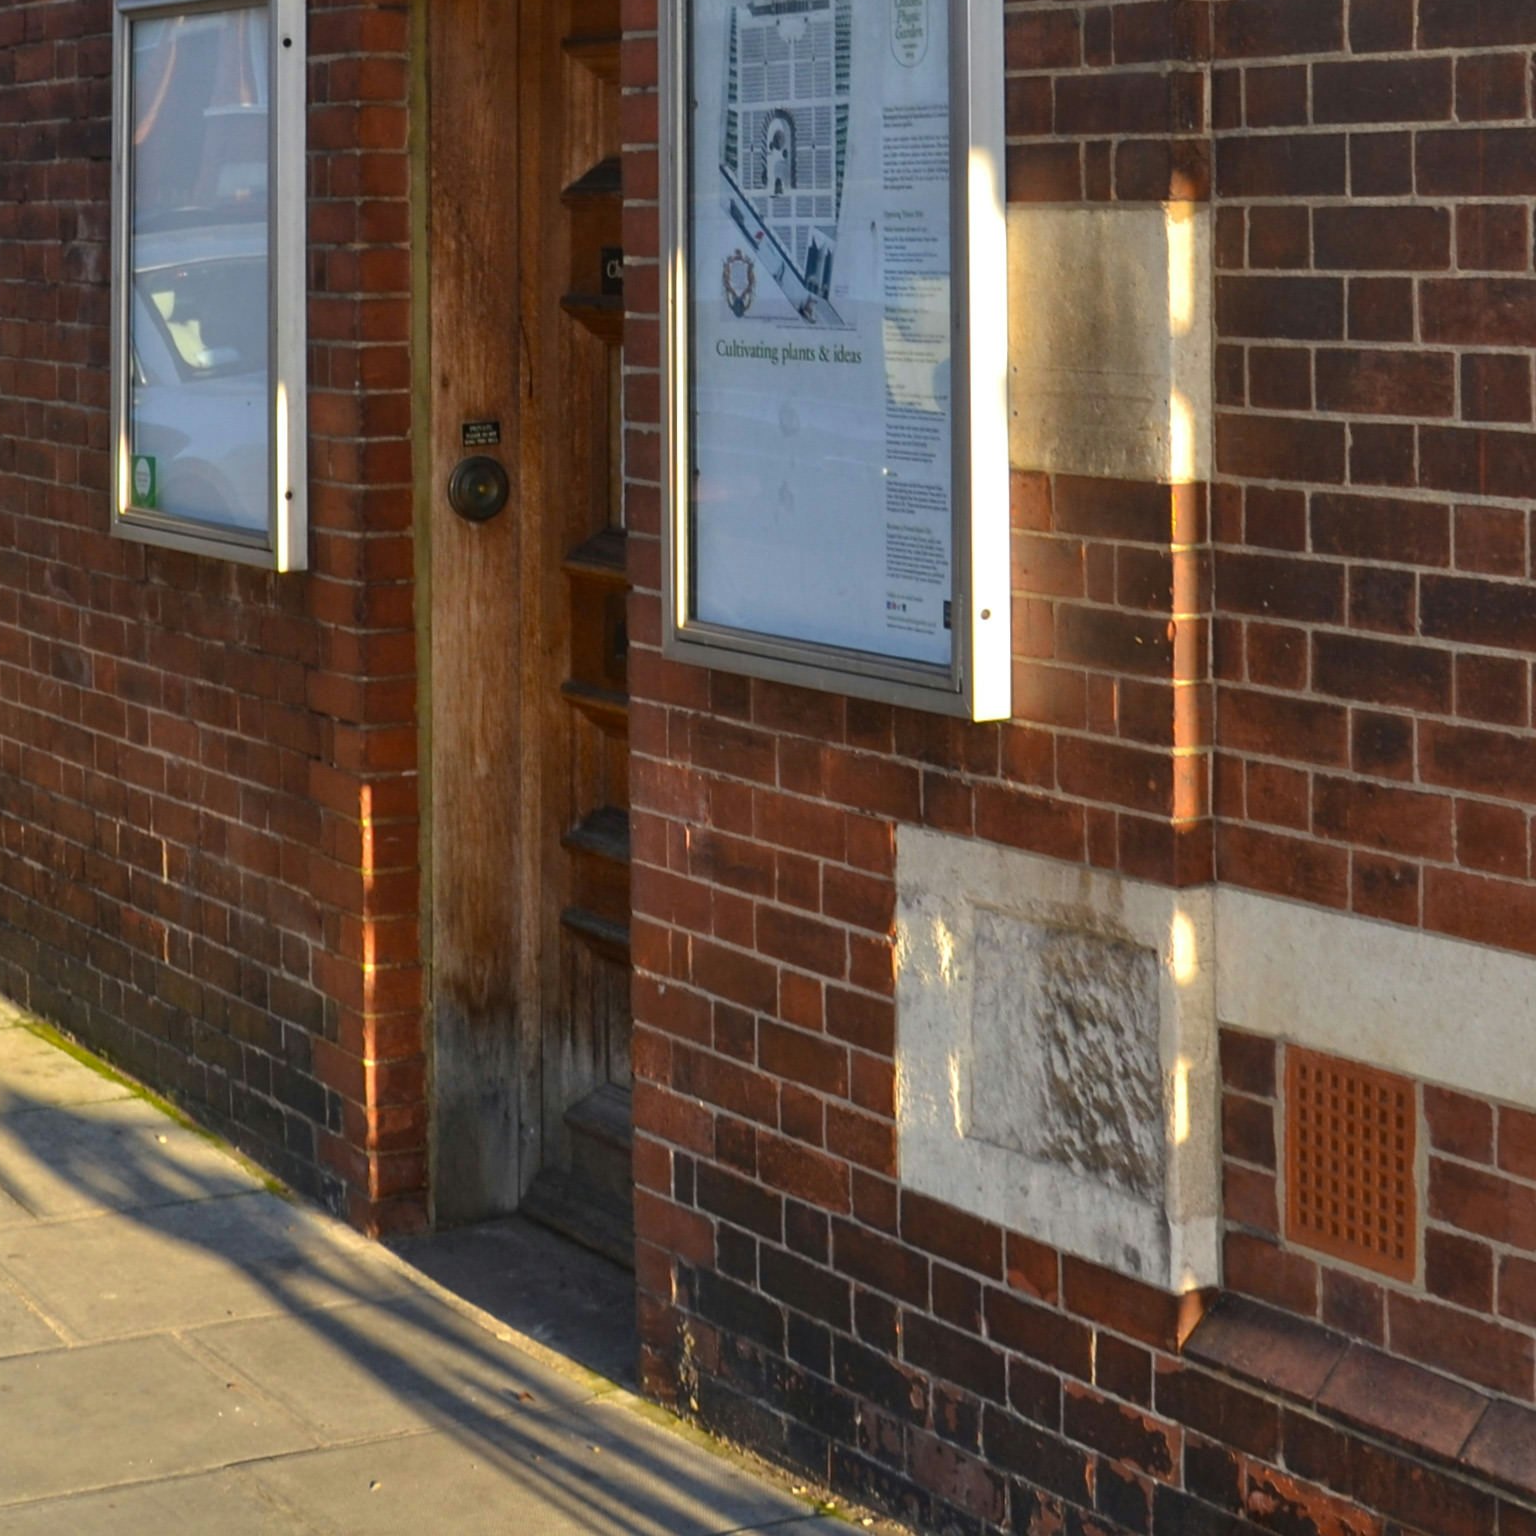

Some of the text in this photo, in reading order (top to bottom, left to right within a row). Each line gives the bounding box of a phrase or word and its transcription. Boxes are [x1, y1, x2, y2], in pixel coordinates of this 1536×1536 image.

[716, 339, 779, 366] Cultivating
[782, 342, 816, 366] plants
[818, 344, 831, 363] &
[833, 343, 863, 365] ideas
